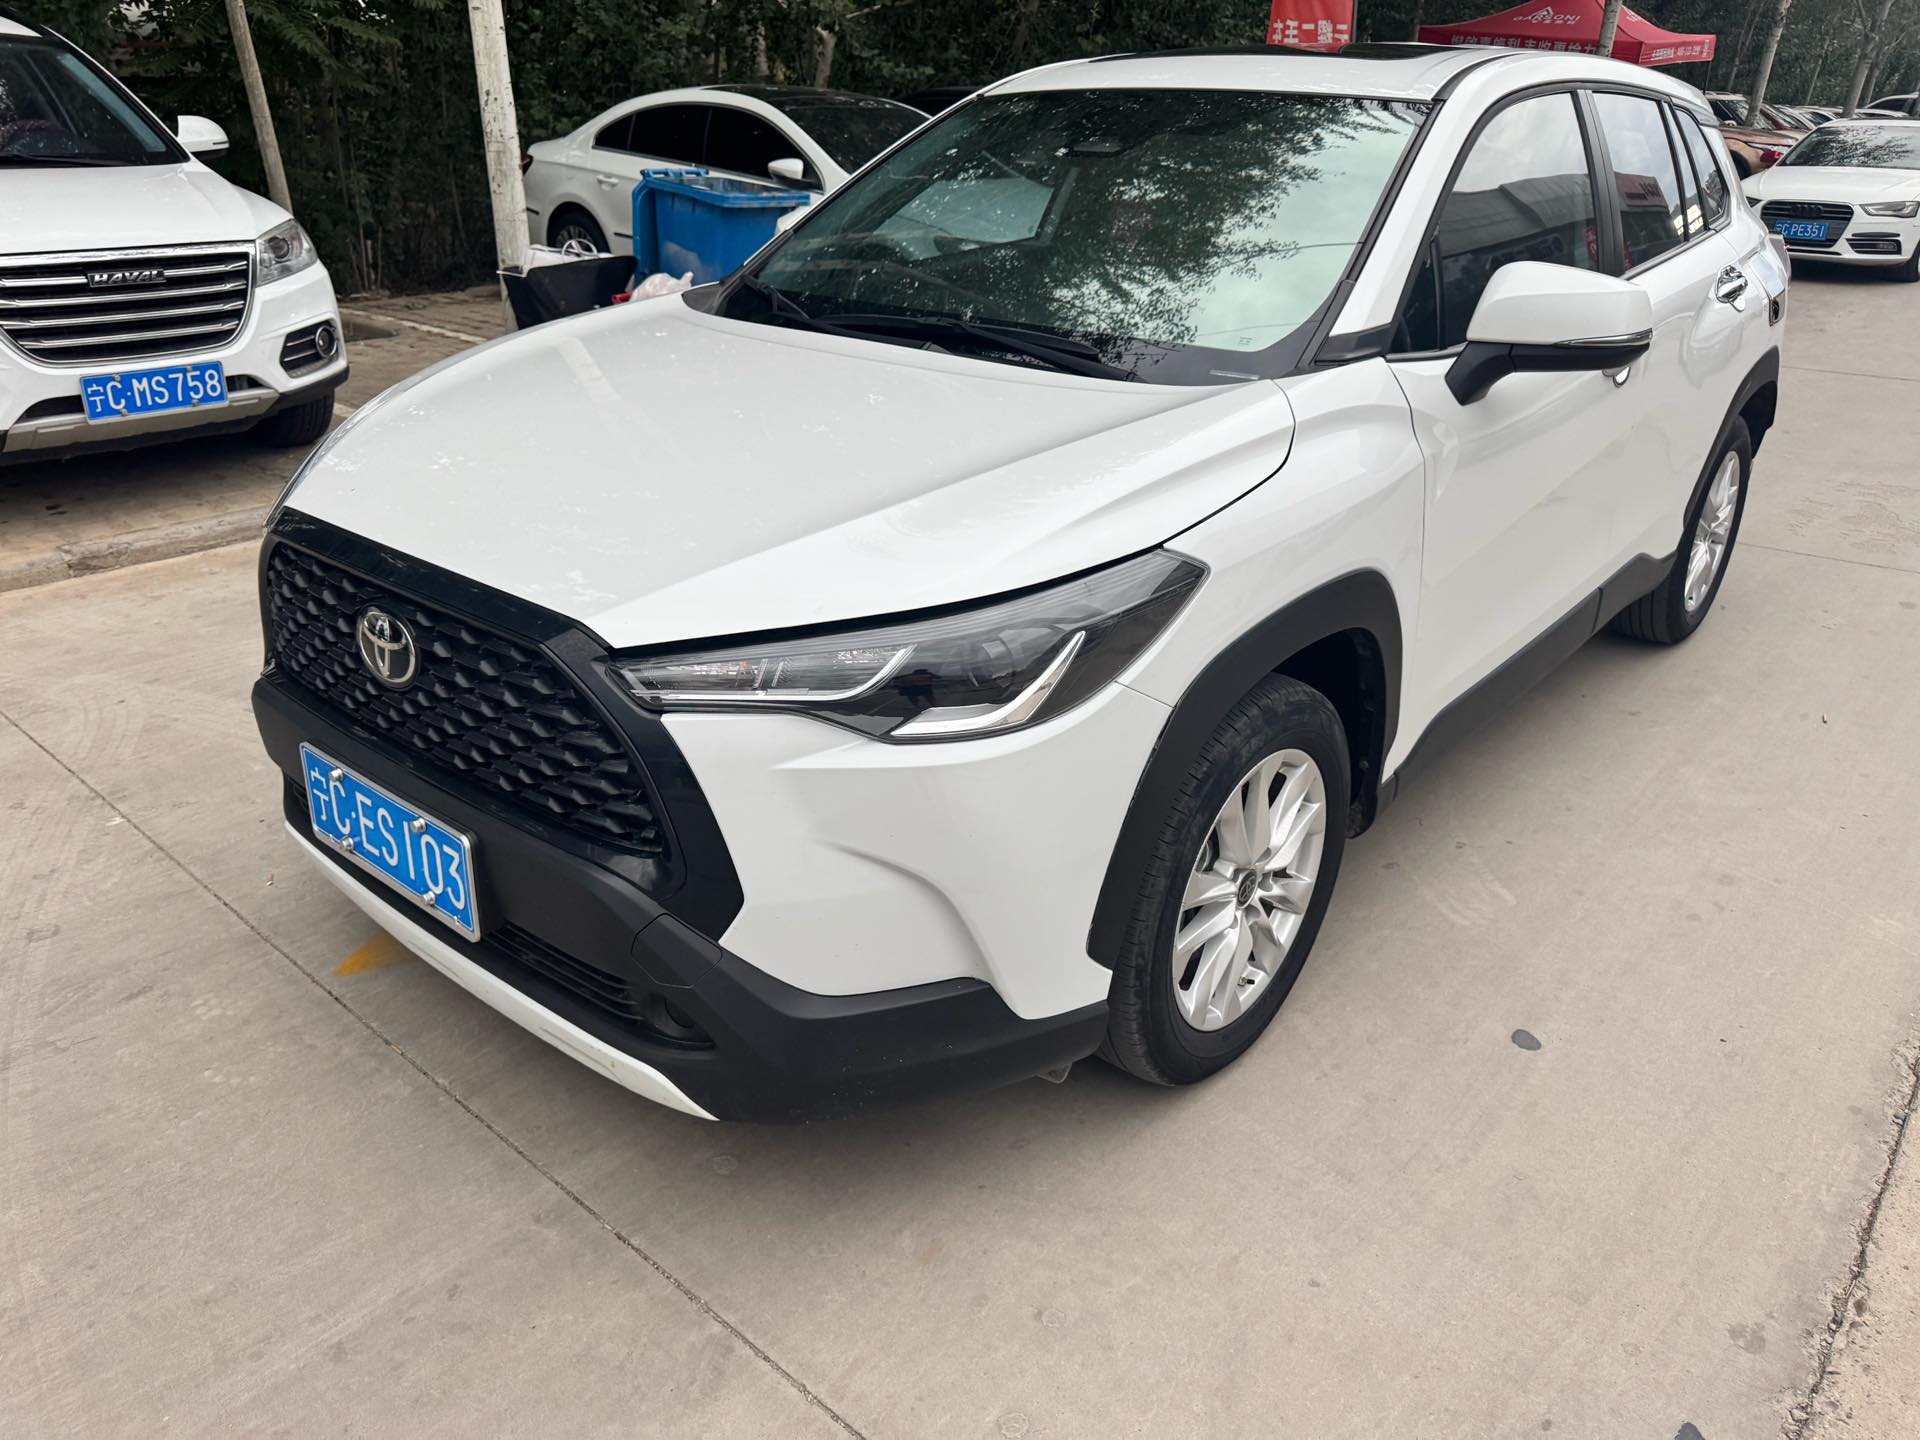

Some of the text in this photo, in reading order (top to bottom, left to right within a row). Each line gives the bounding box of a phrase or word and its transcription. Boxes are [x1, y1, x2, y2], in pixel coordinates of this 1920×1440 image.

[93, 270, 164, 285] HAVAL
[87, 369, 222, 413] 宁C·MS758
[310, 767, 465, 910] 宁C·ES103
